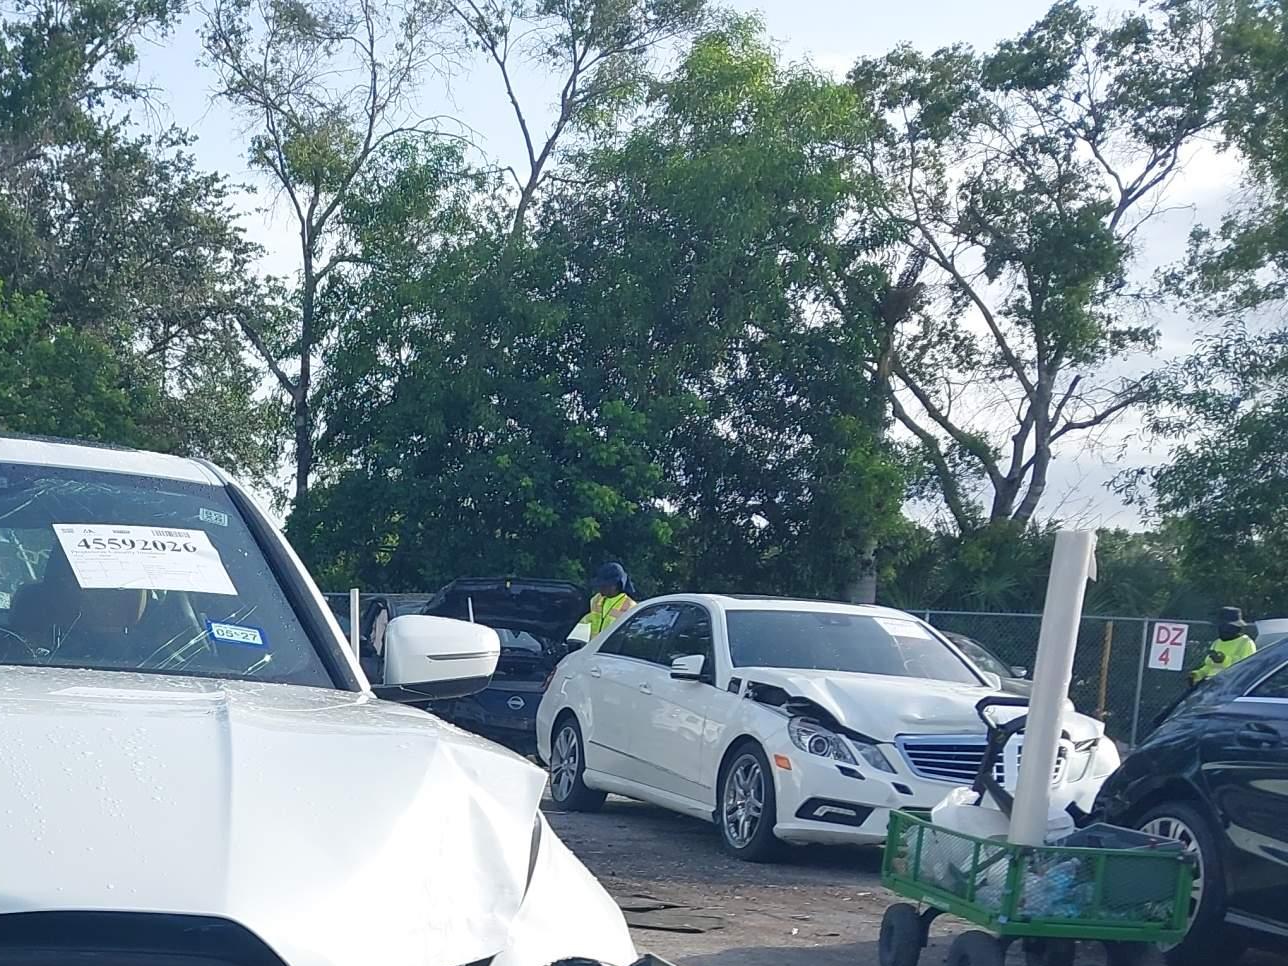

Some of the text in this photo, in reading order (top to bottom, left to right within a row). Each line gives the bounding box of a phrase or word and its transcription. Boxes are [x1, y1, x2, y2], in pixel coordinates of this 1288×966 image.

[77, 537, 197, 553] 45592026
[1156, 625, 1185, 646] DZ
[1158, 647, 1170, 665] 4
